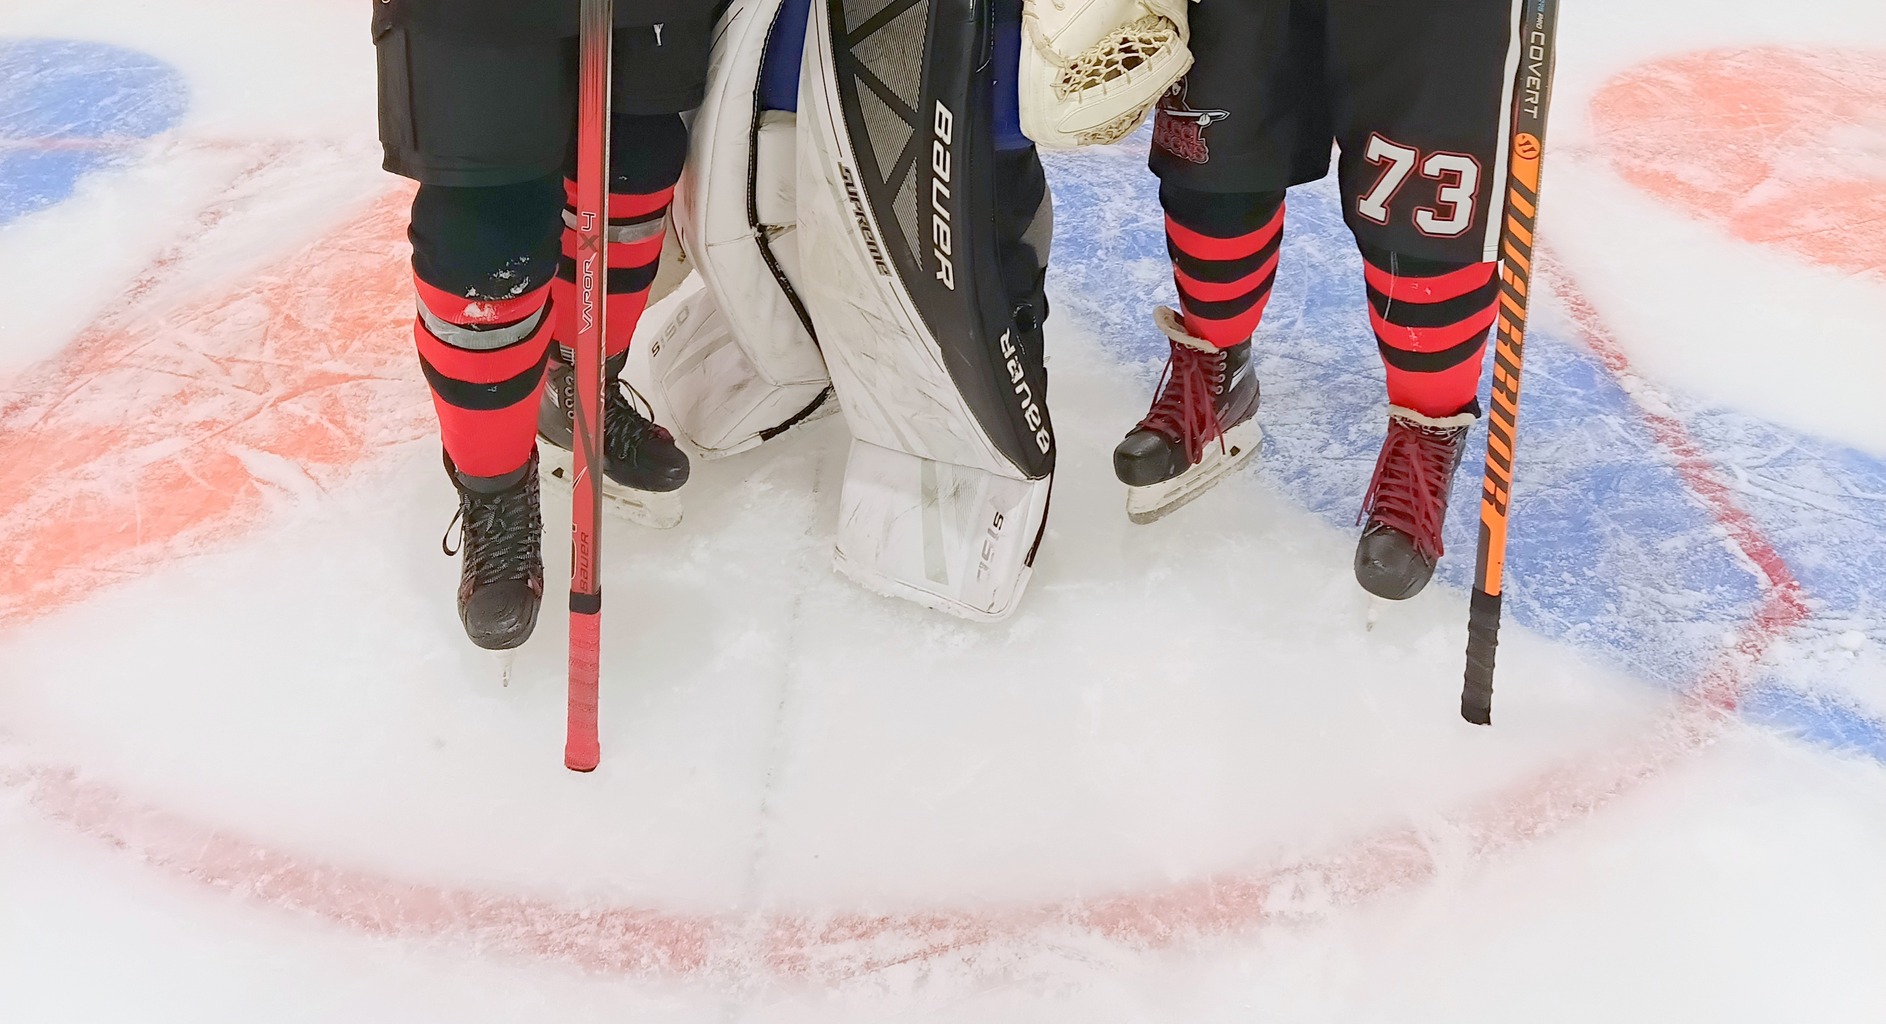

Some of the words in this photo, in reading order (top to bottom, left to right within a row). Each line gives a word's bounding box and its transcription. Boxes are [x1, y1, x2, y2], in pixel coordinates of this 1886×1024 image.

[1524, 30, 1546, 119] COVERT
[838, 161, 893, 277] SUPREME
[931, 99, 955, 291] BAUER
[1357, 131, 1481, 238] 73
[578, 252, 597, 335] VAPOR
[1482, 176, 1537, 518] WARRIOR
[999, 327, 1051, 455] BAUER
[579, 532, 590, 593] BAUER
